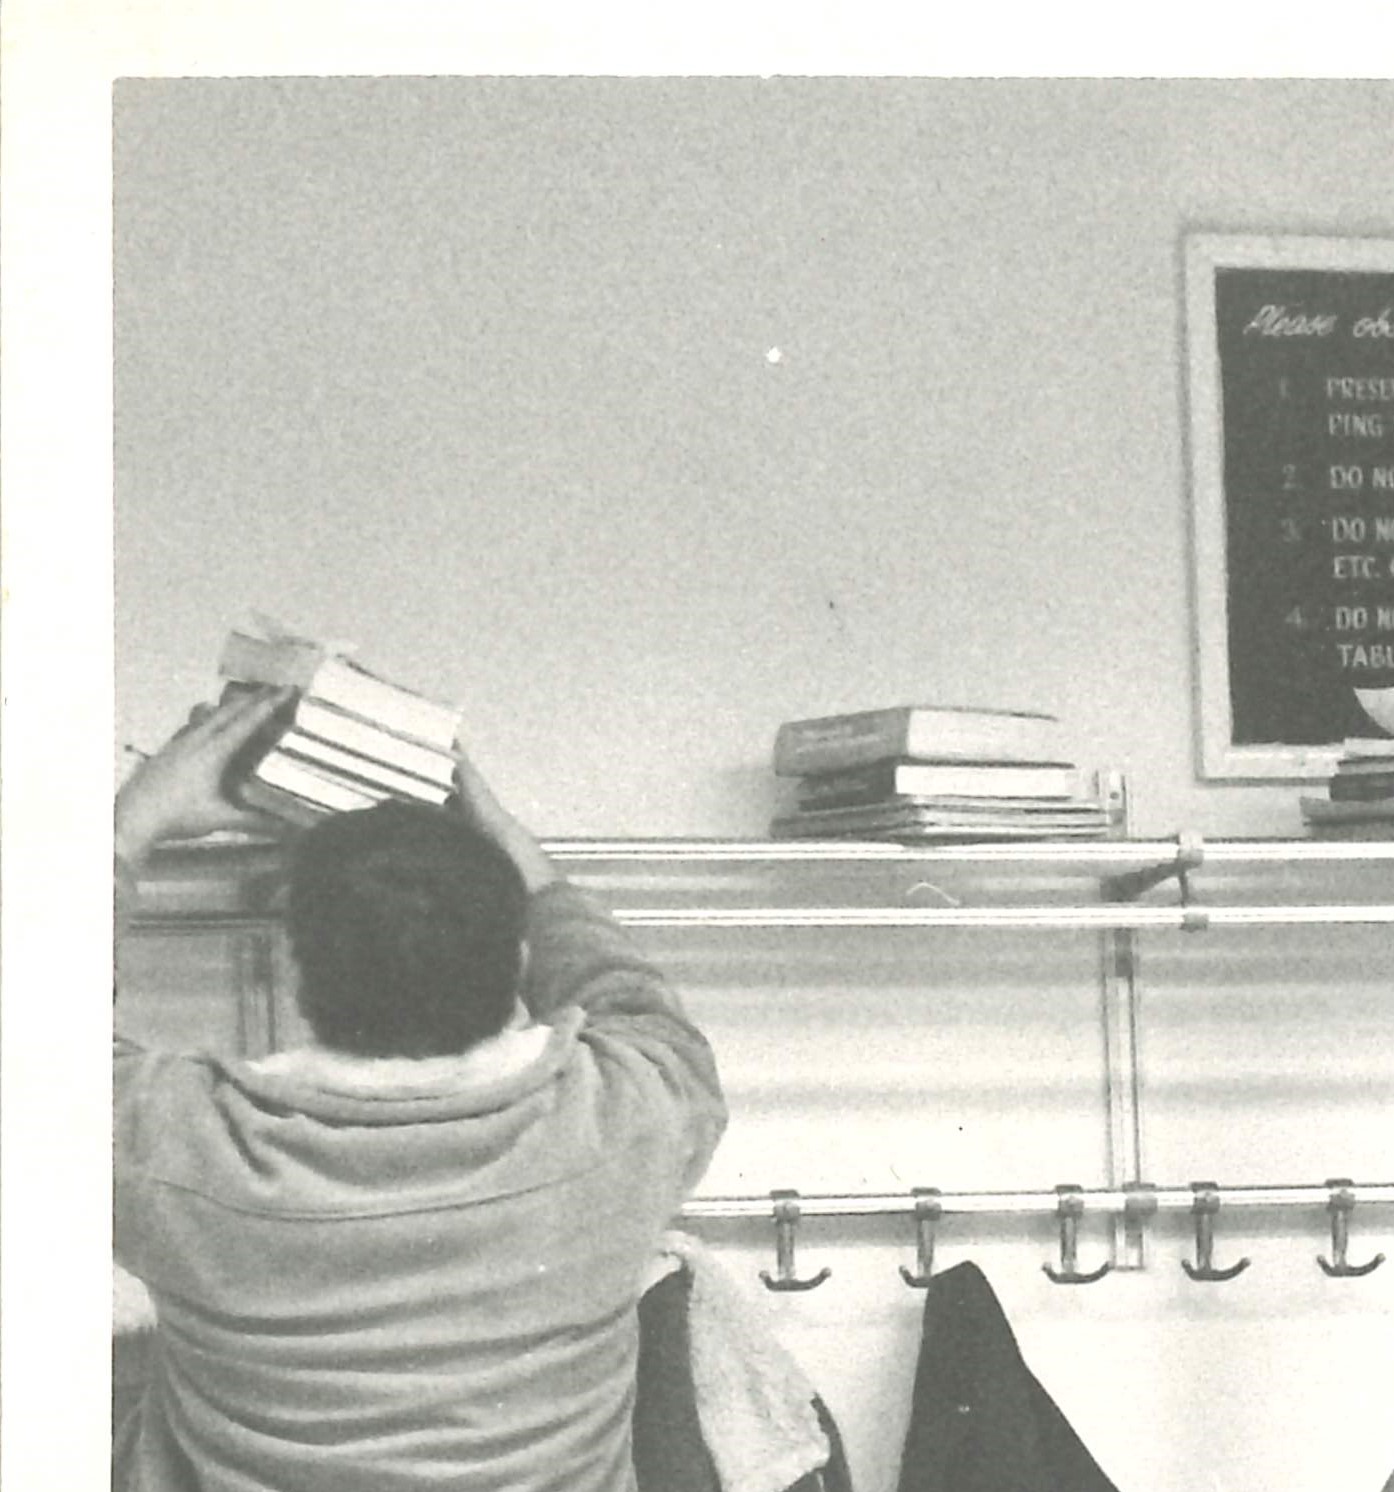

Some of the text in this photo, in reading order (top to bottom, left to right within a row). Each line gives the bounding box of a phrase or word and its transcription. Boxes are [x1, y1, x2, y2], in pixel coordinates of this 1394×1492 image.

[1243, 304, 1337, 337] Please
[1328, 413, 1384, 437] PING
[1329, 465, 1364, 489] DO
[1331, 516, 1367, 543] DO
[1335, 606, 1368, 630] DO
